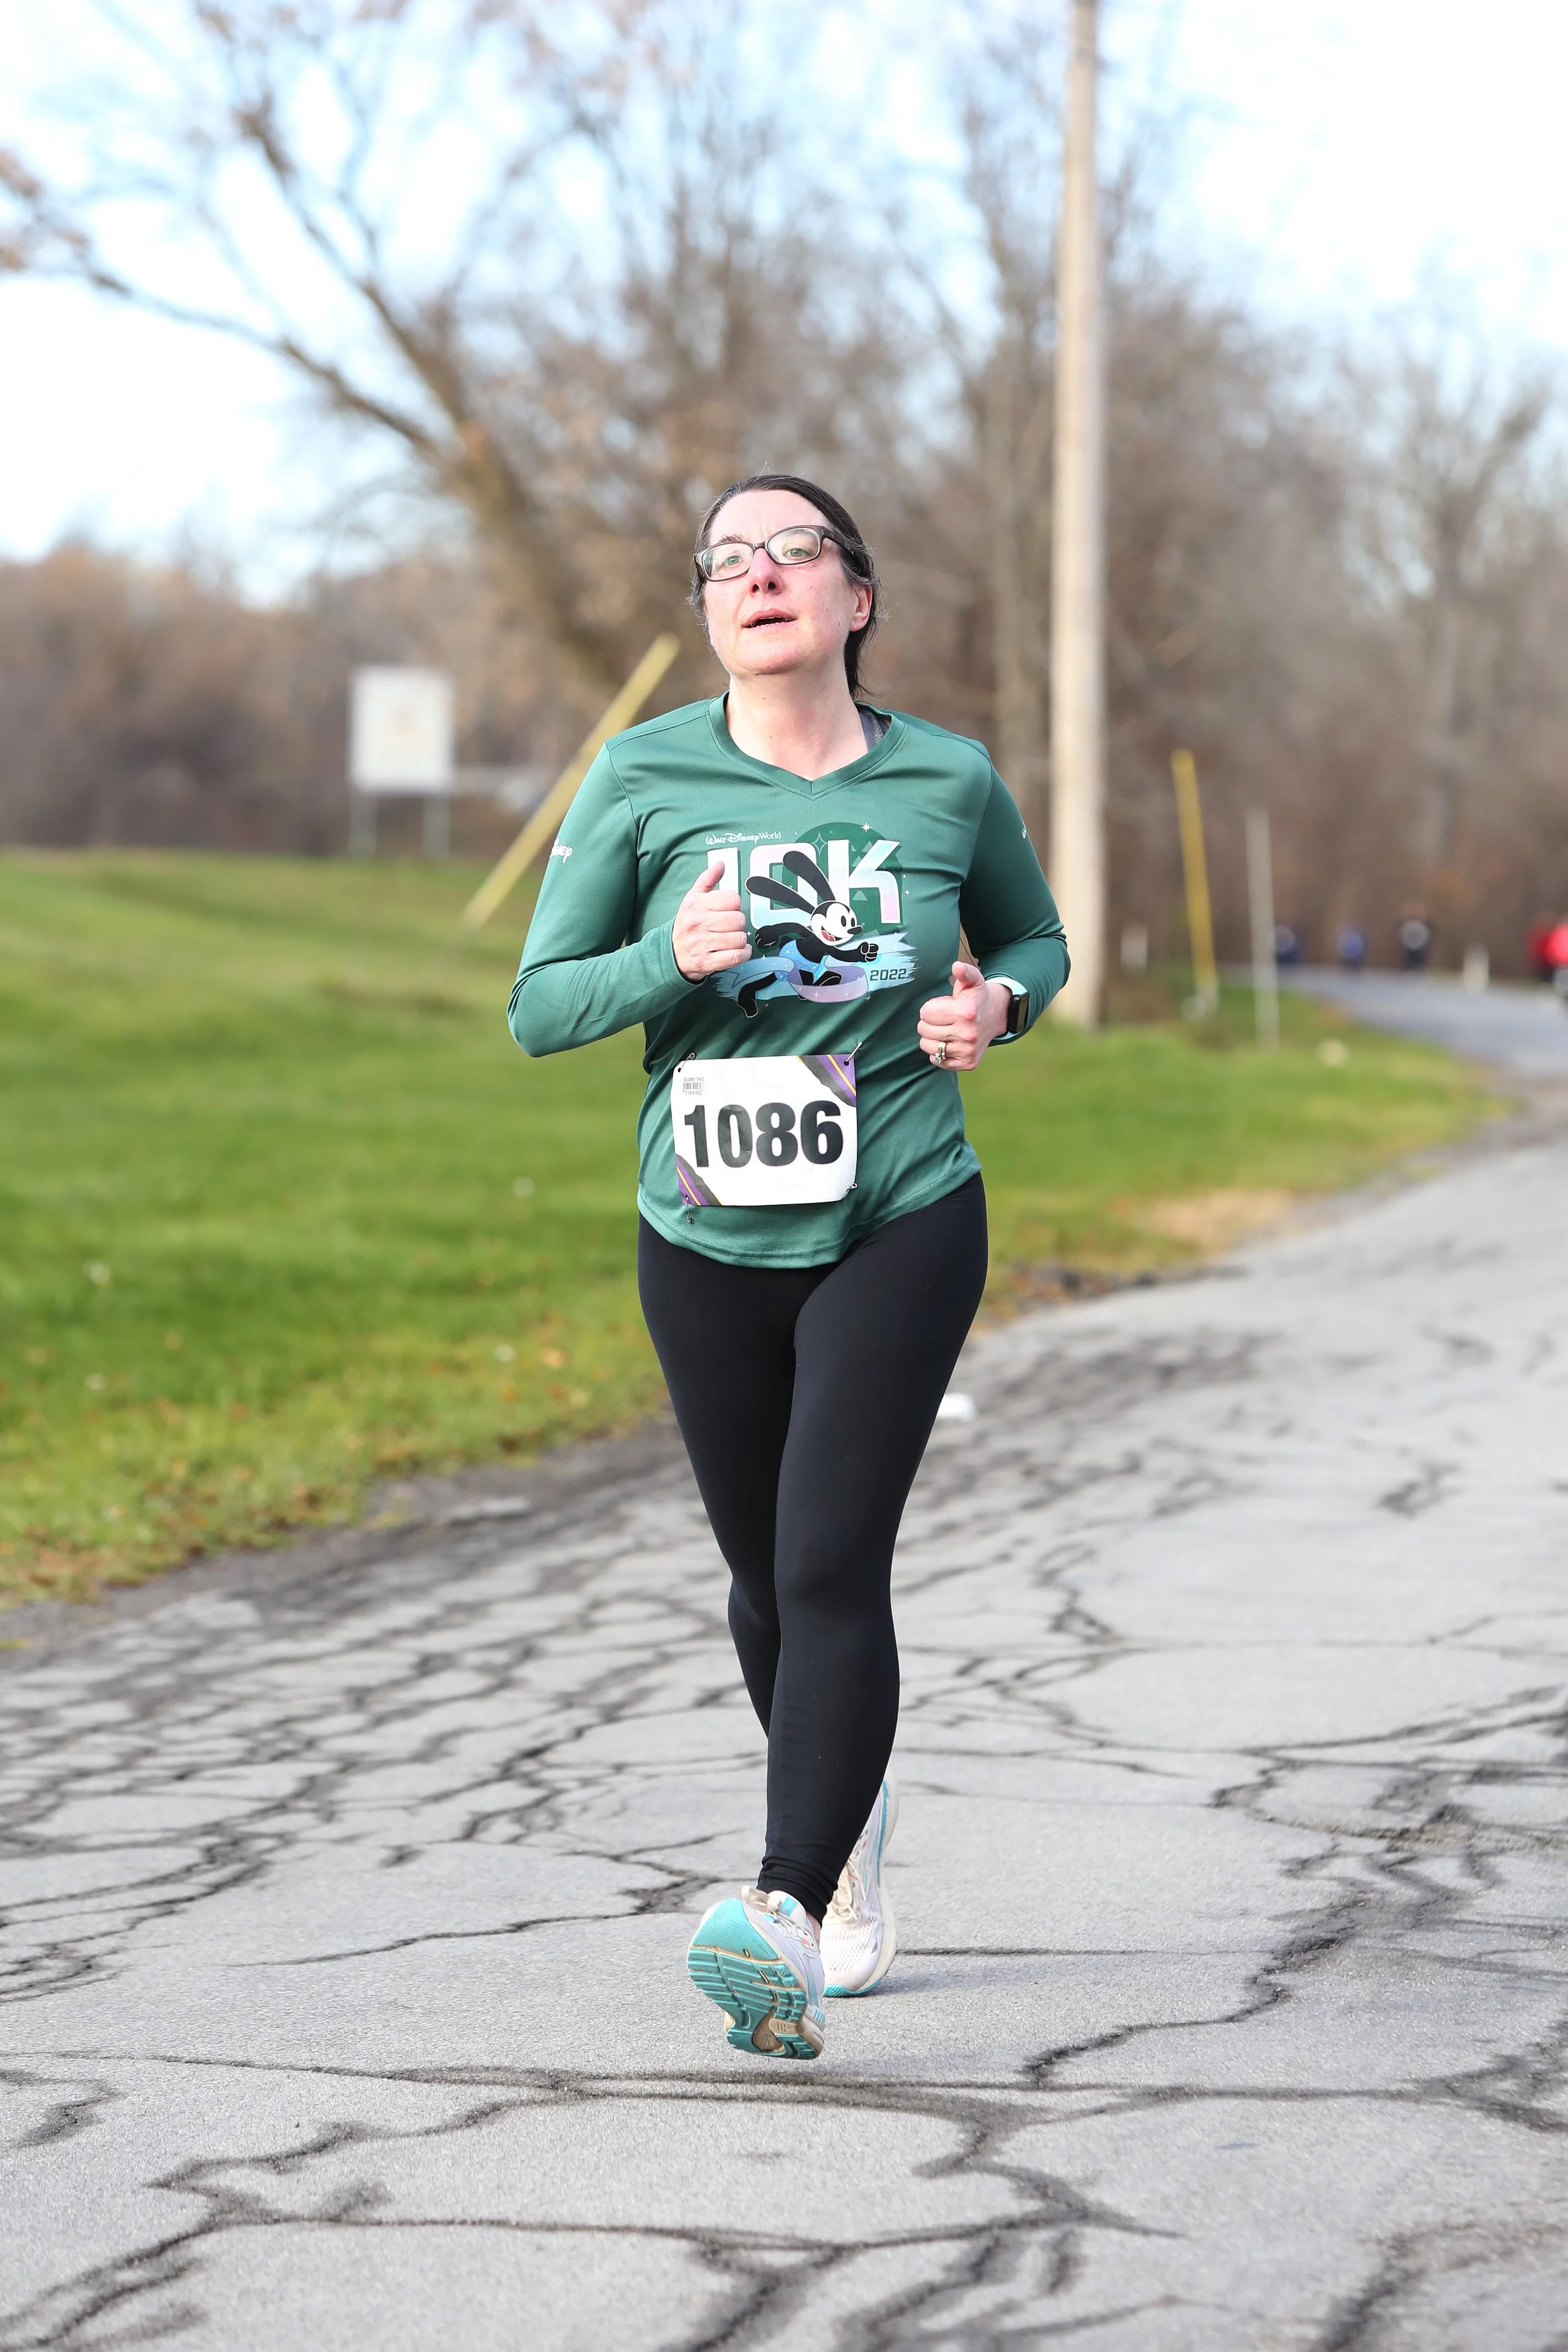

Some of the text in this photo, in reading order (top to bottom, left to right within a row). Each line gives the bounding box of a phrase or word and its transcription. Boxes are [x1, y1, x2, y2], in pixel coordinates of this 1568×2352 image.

[758, 831, 781, 840] World
[870, 968, 907, 981] 2022
[684, 1100, 844, 1168] 1086
